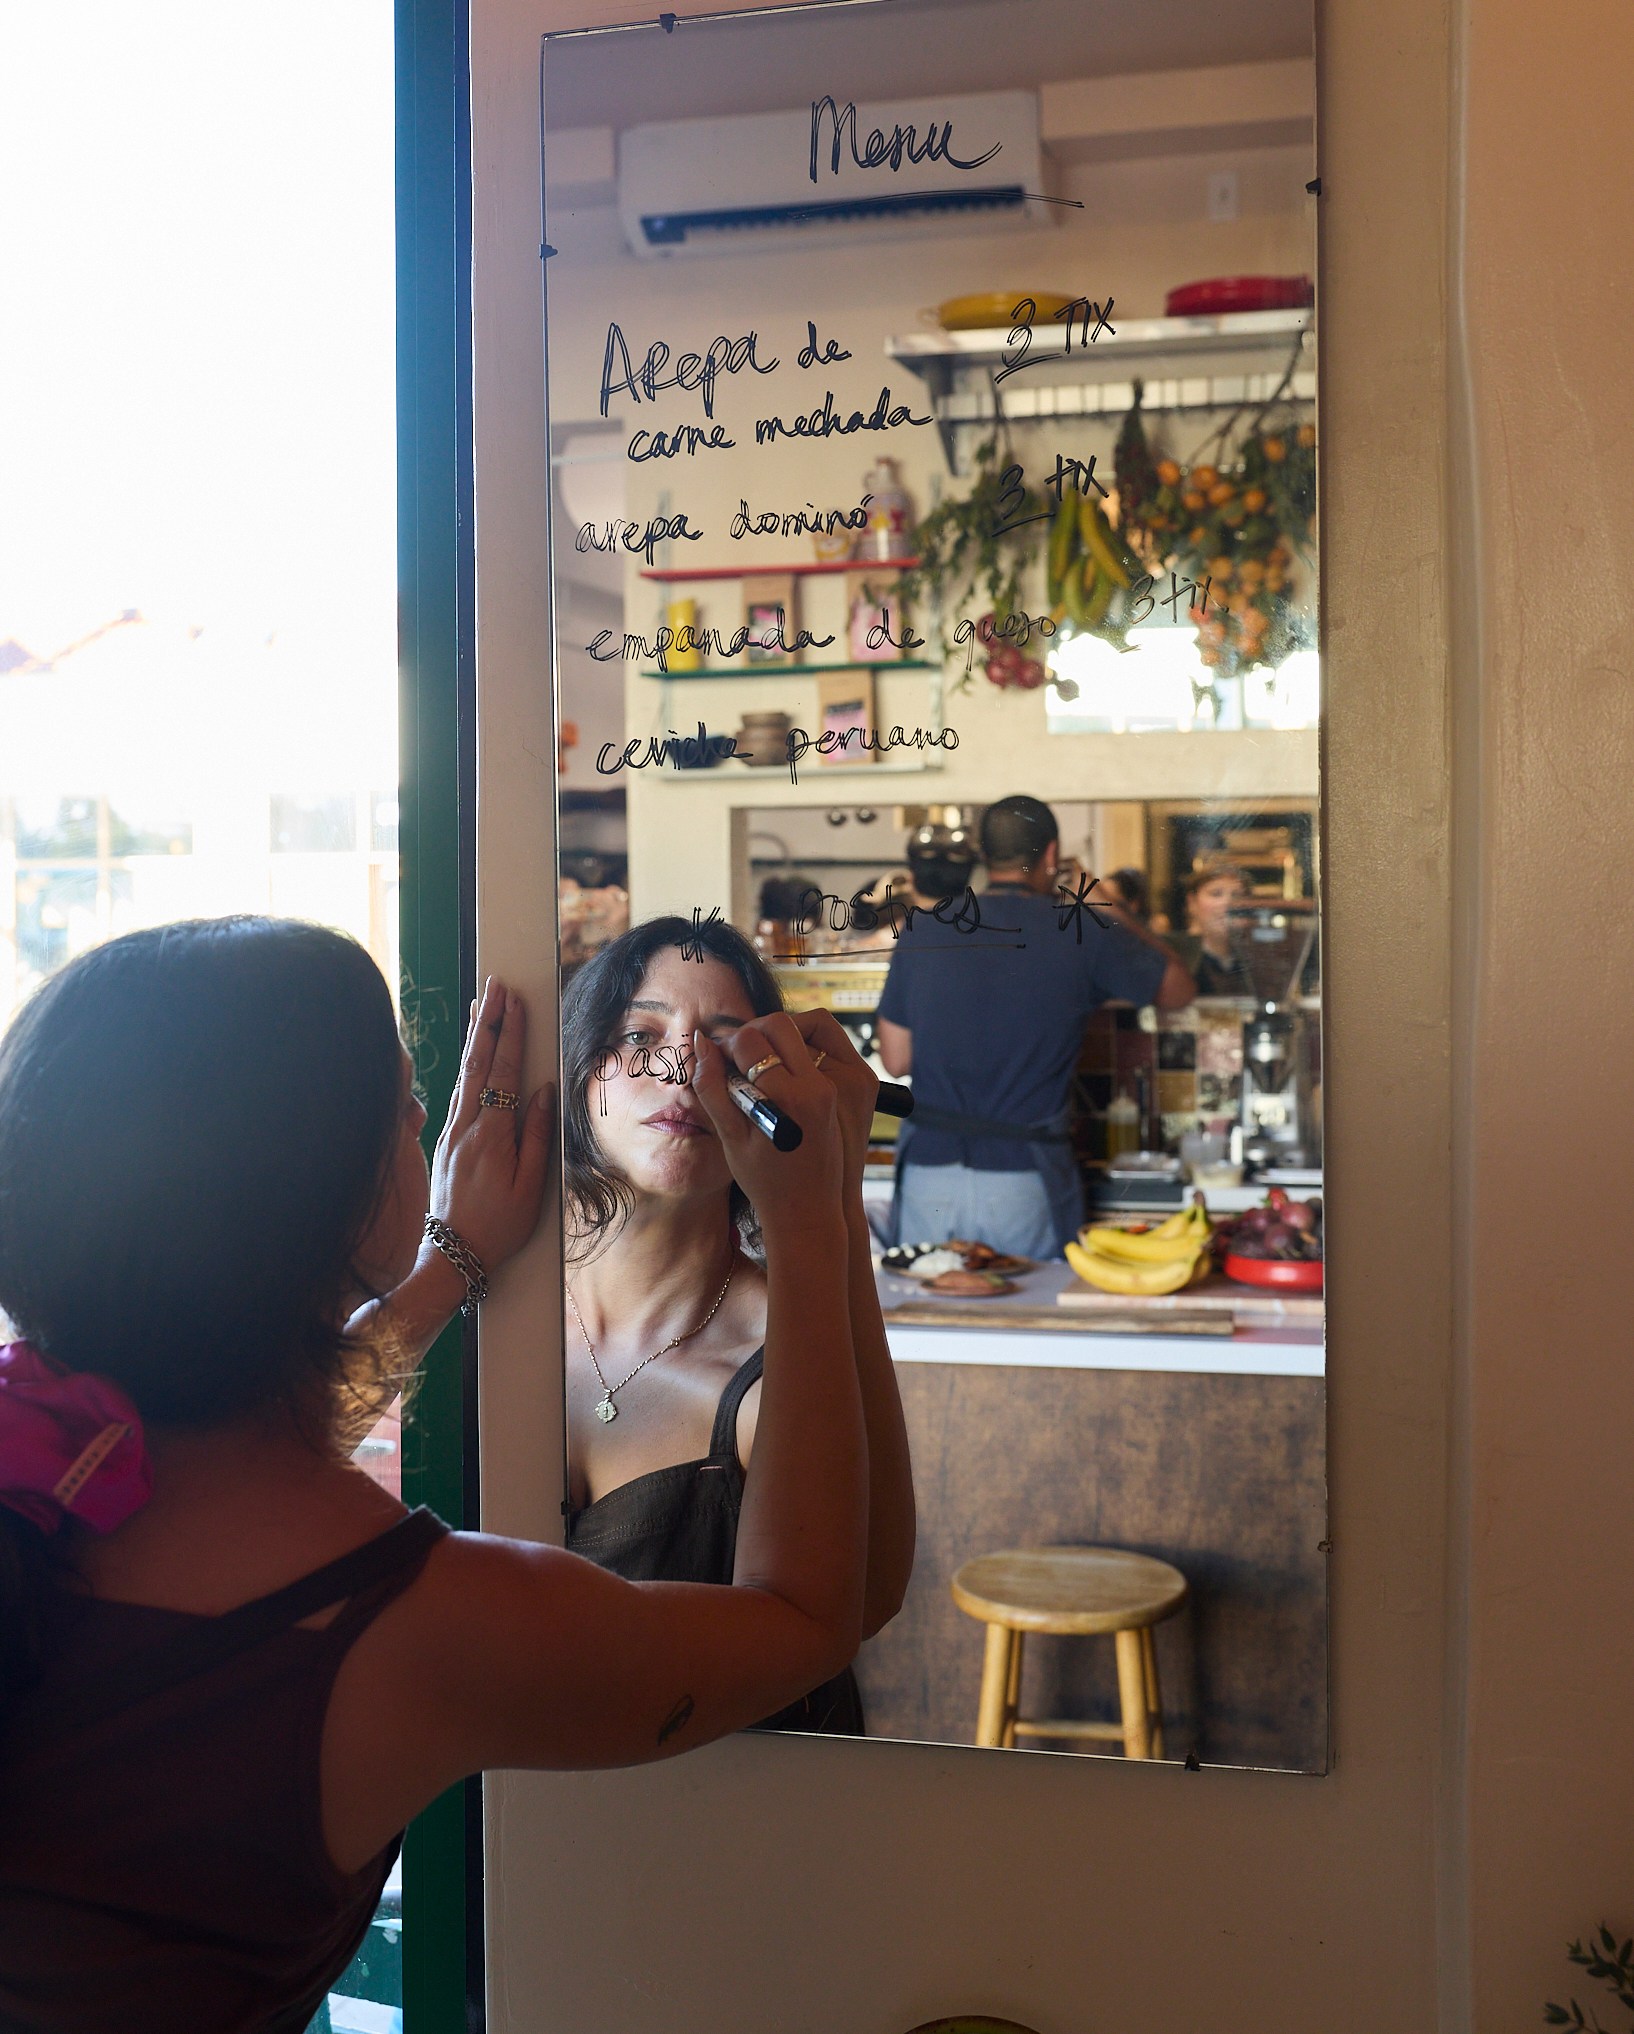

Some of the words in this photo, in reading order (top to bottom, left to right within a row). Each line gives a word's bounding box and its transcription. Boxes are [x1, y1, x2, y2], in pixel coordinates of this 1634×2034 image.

[809, 95, 1002, 182] Menu
[798, 321, 852, 368] de
[627, 424, 736, 462] carne
[755, 387, 933, 445] mechada
[575, 513, 704, 566] arepa
[998, 463, 1026, 520] 3
[585, 607, 836, 673] empanada
[865, 607, 926, 651] de
[1131, 573, 1156, 625] 3
[785, 725, 961, 786] peruano
[793, 885, 1022, 967] postres
